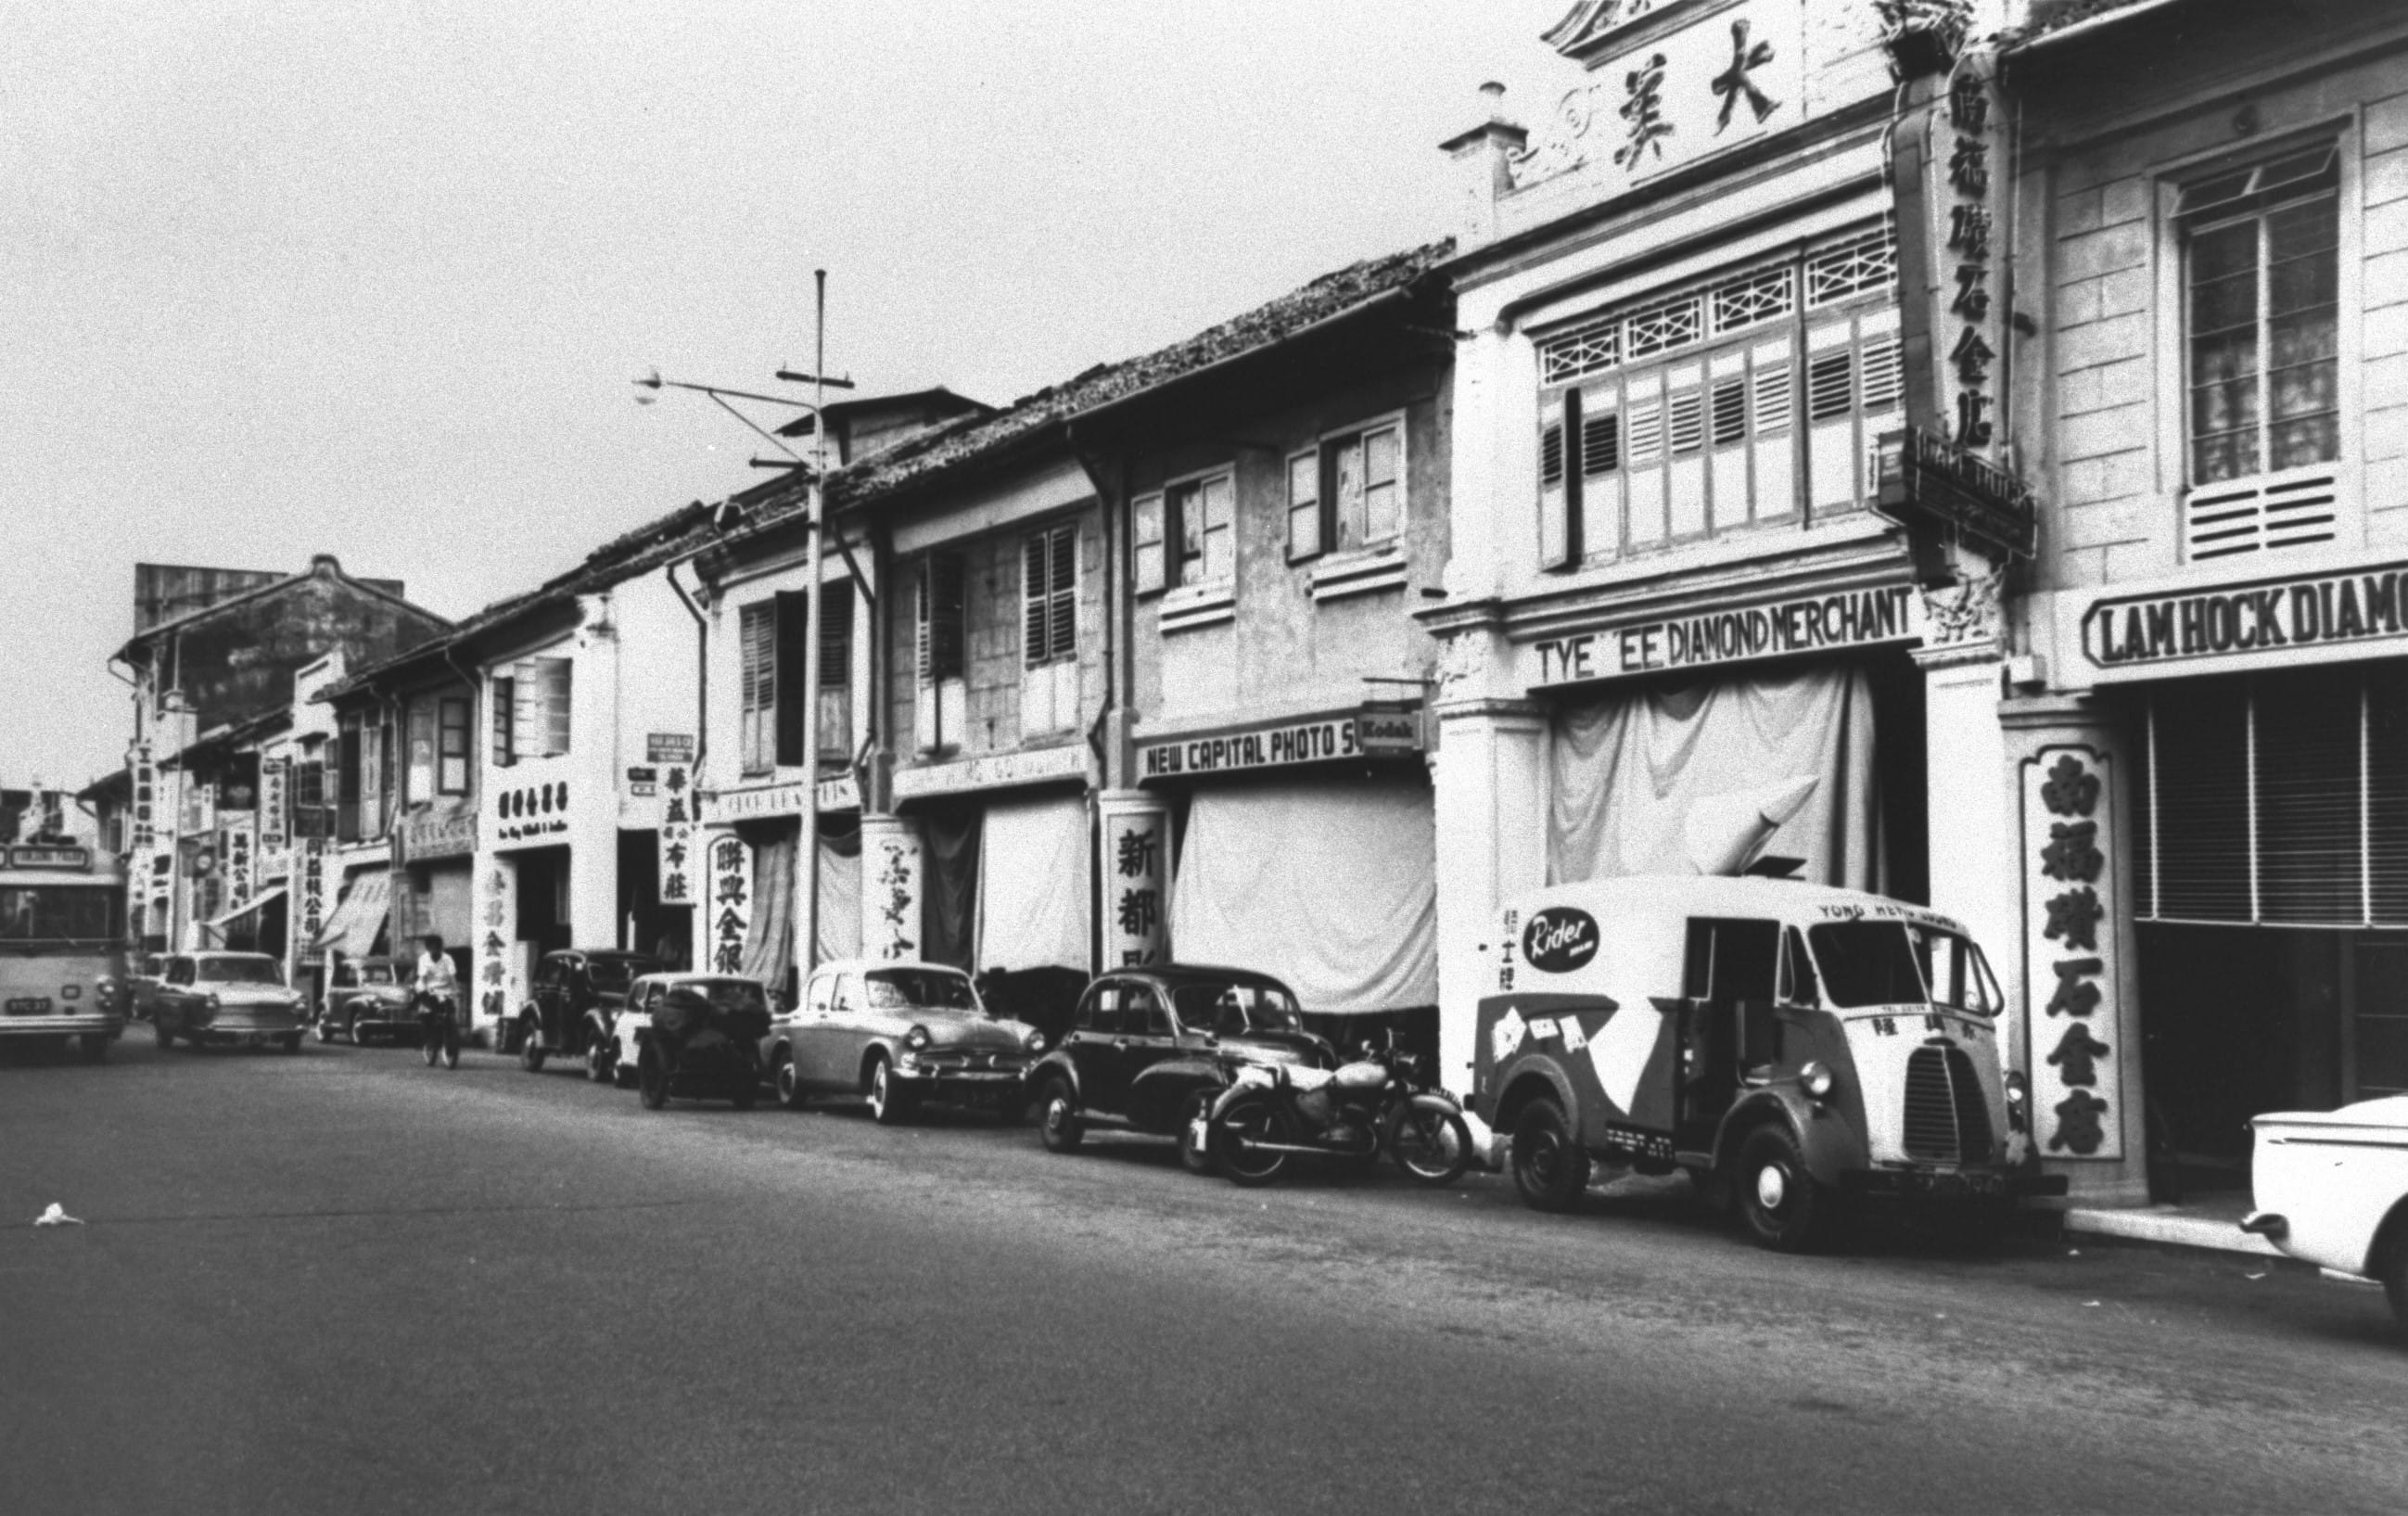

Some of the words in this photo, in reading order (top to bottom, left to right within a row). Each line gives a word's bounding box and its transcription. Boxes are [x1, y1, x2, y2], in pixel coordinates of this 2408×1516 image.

[1535, 635, 1596, 684] TYE
[1599, 622, 1664, 672] EE
[1668, 607, 1770, 667] DIAMOND
[1770, 584, 1915, 652] MERCHANT
[2100, 601, 2176, 662] LAM
[2180, 587, 2287, 655] HOCK
[1146, 745, 1183, 775] NEW
[1188, 735, 1267, 771] CAPITAL
[1271, 723, 1335, 761] PHOTO
[1342, 721, 1364, 755] S
[1361, 720, 1415, 740] Kodak
[1531, 914, 1586, 960] Rider
